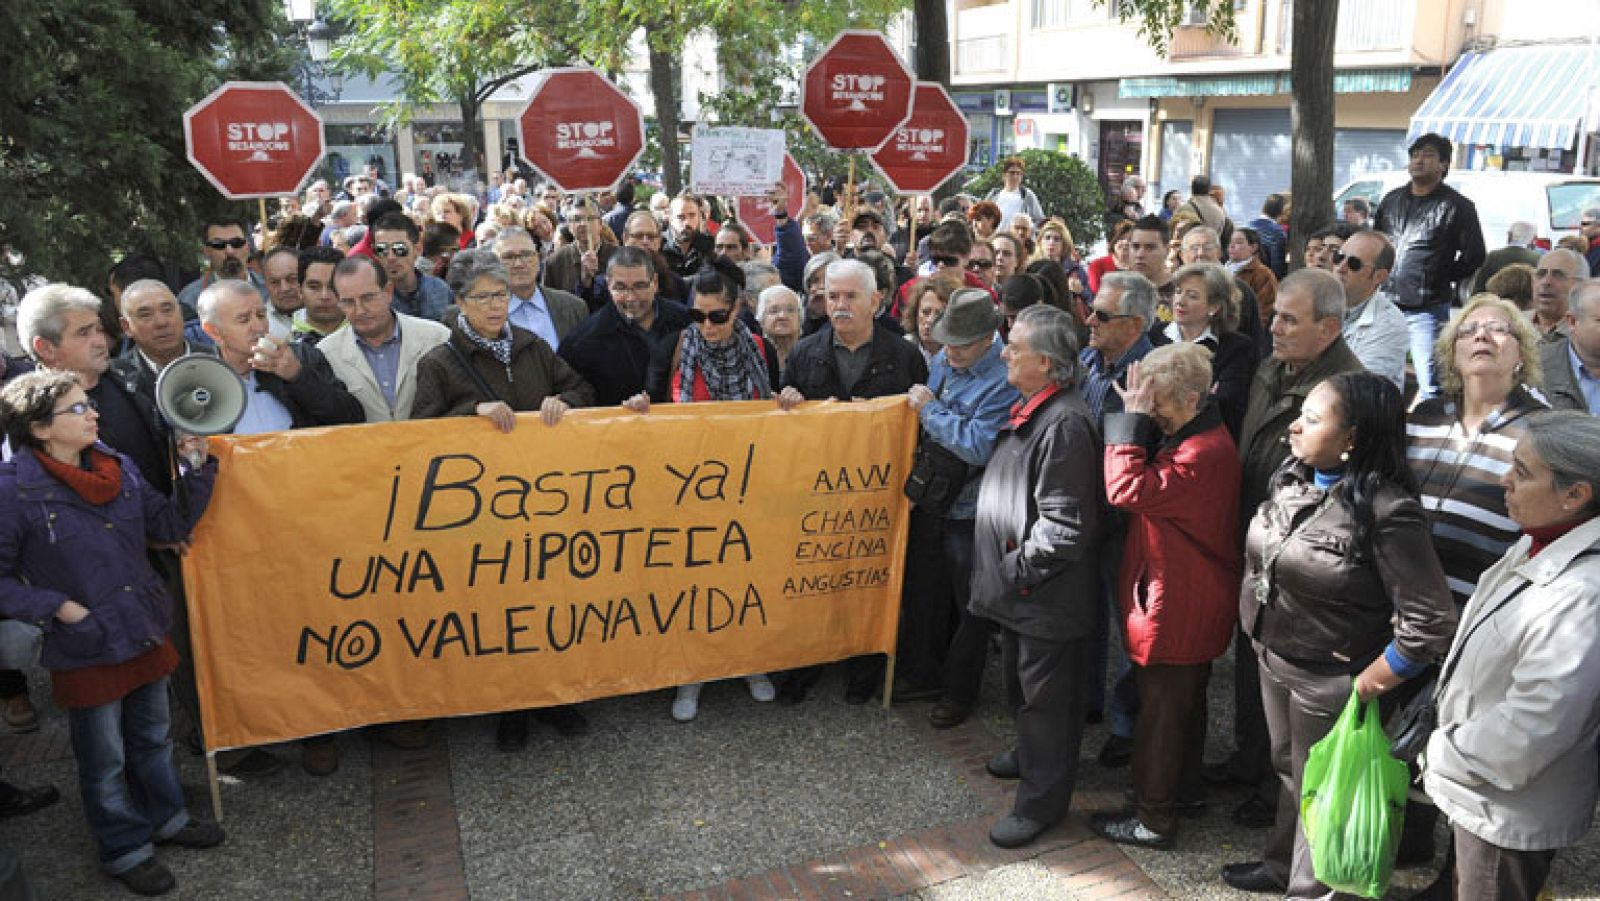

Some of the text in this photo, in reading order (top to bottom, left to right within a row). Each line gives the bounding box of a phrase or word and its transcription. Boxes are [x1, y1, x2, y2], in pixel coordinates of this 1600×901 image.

[831, 74, 886, 91] STOP
[227, 123, 289, 140] STOP
[556, 121, 613, 138] STOP
[897, 128, 945, 143] STOP
[665, 443, 755, 506] ya!
[801, 506, 890, 533] CHANA
[795, 535, 886, 560] ENCINA
[330, 548, 445, 600] UNA
[783, 566, 890, 593] ANGUSTIAS
[296, 584, 768, 669] NO VALE UNA VIDA
